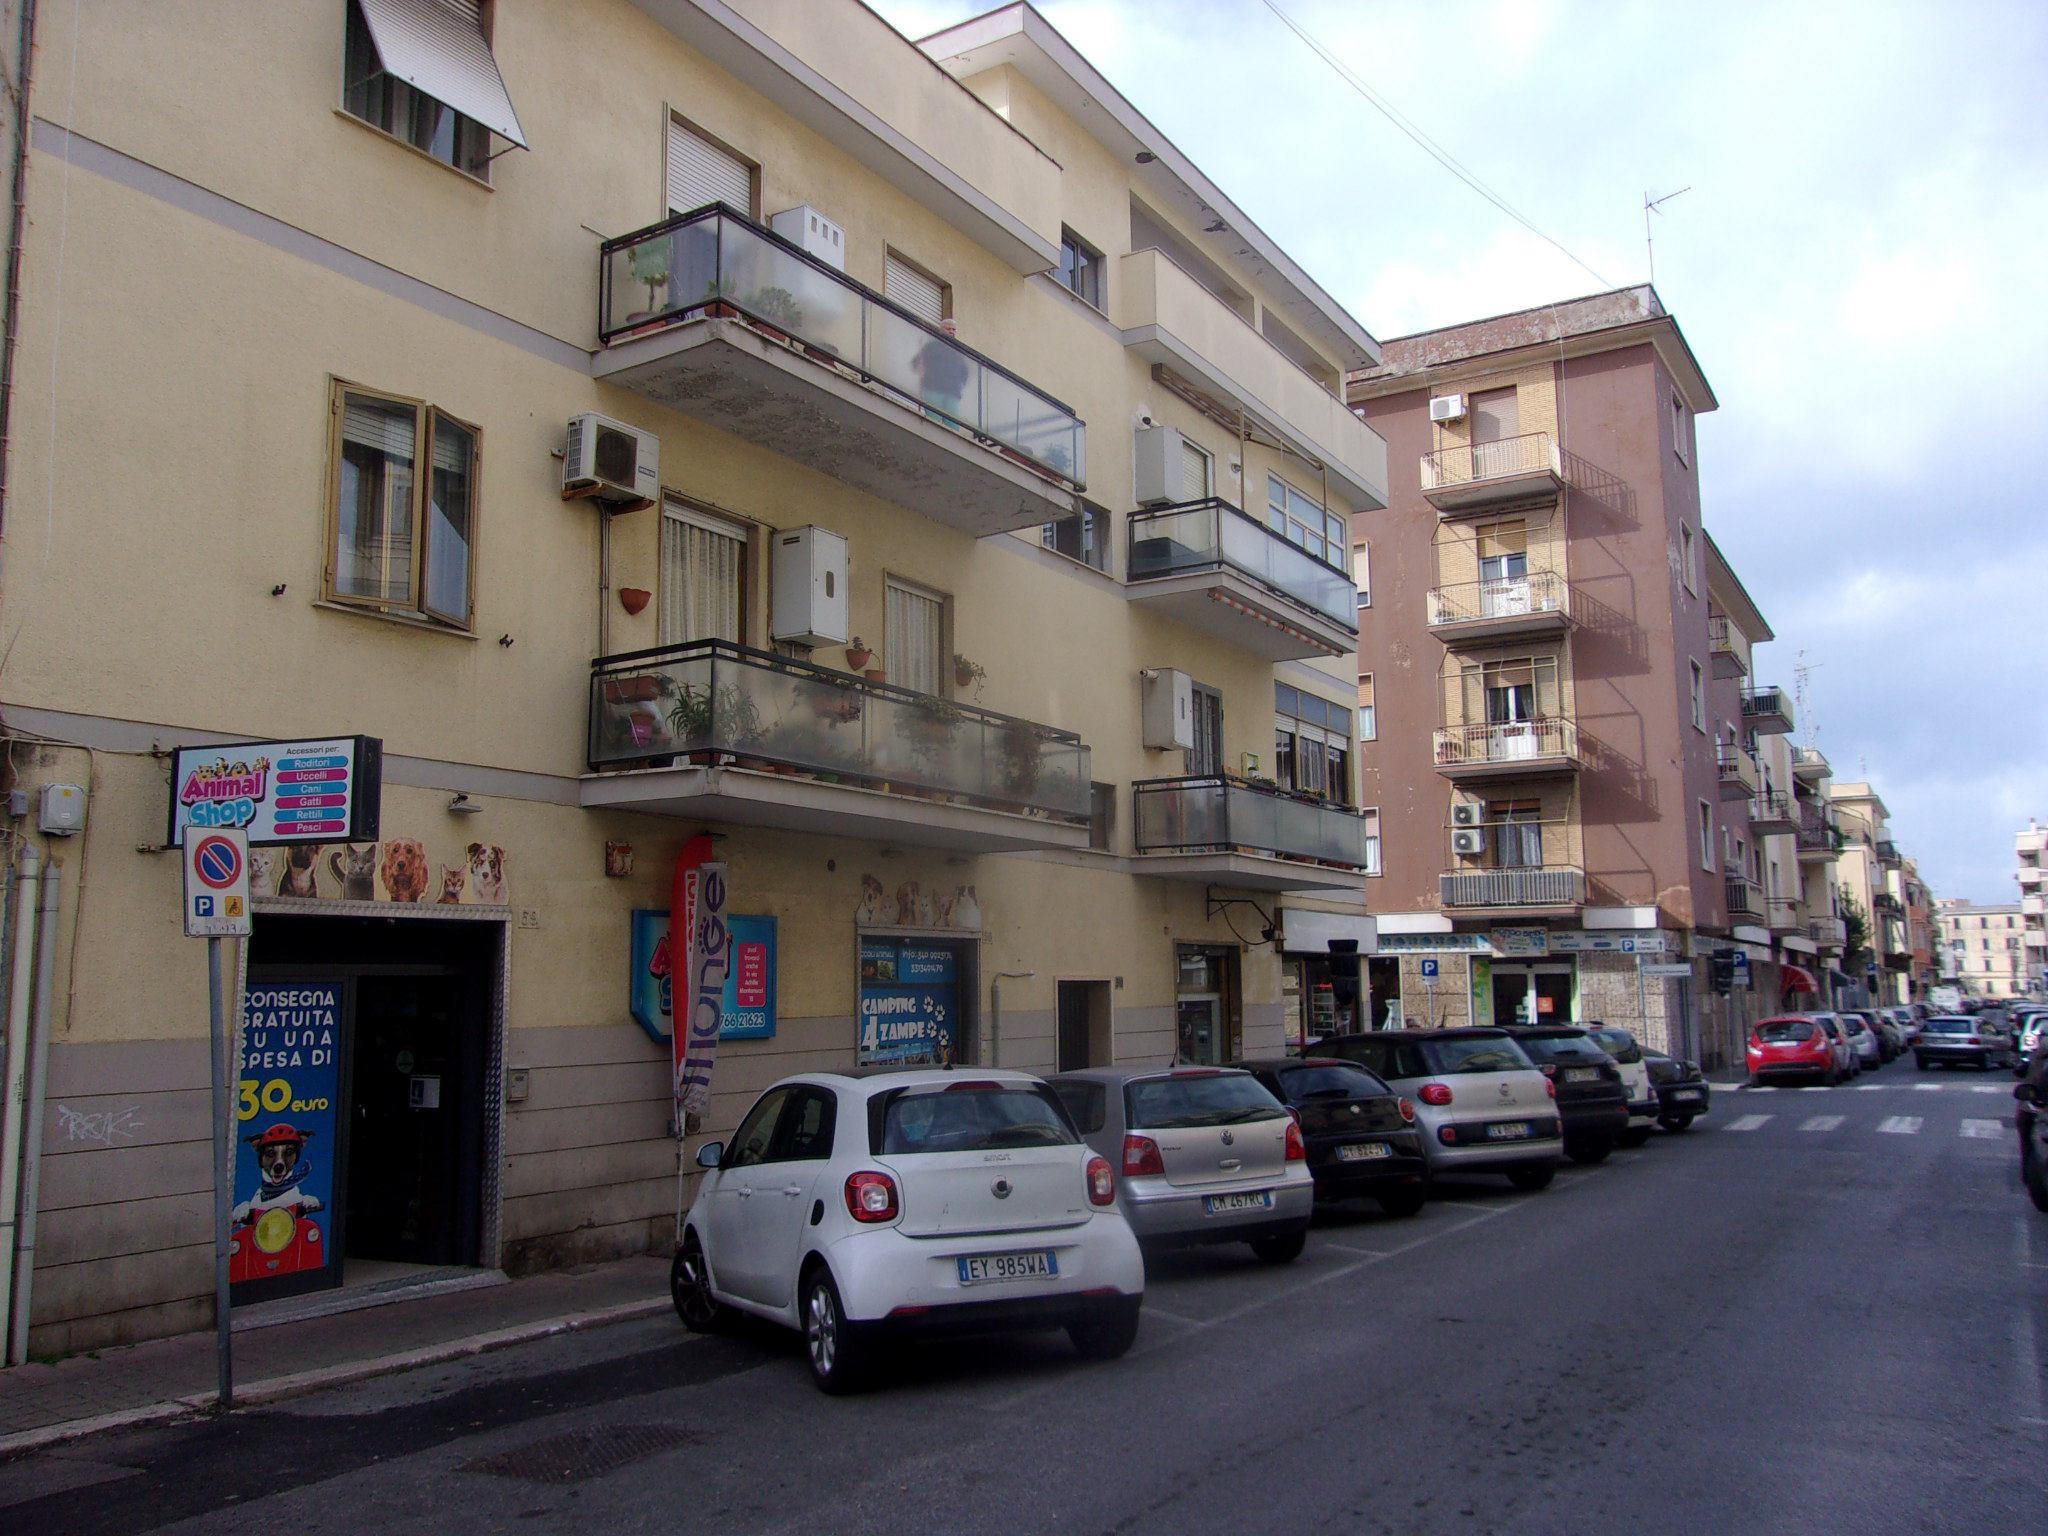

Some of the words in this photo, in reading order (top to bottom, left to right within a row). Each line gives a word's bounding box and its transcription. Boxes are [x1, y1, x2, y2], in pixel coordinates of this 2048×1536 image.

[286, 746, 323, 755] Accessori
[294, 758, 330, 768] Roditori
[296, 771, 327, 781] Uccelli
[183, 773, 262, 799] Animal
[300, 784, 321, 794] Cani
[299, 797, 322, 806] Gatti
[296, 809, 323, 820] Rettili
[296, 823, 322, 833] Pesci
[199, 898, 211, 916] P
[1624, 941, 1633, 951] P
[1425, 962, 1435, 974] P
[862, 997, 916, 1015] CAMPING
[241, 1010, 334, 1028] GRATUITA
[738, 1013, 765, 1027] 21623
[861, 1015, 879, 1051] 4
[880, 1021, 925, 1041] ZAMPE
[311, 1049, 331, 1066] DI
[238, 1078, 292, 1120] 30
[291, 1098, 328, 1112] euro
[969, 1259, 988, 1279] EY
[996, 1256, 1047, 1276] 985WA
